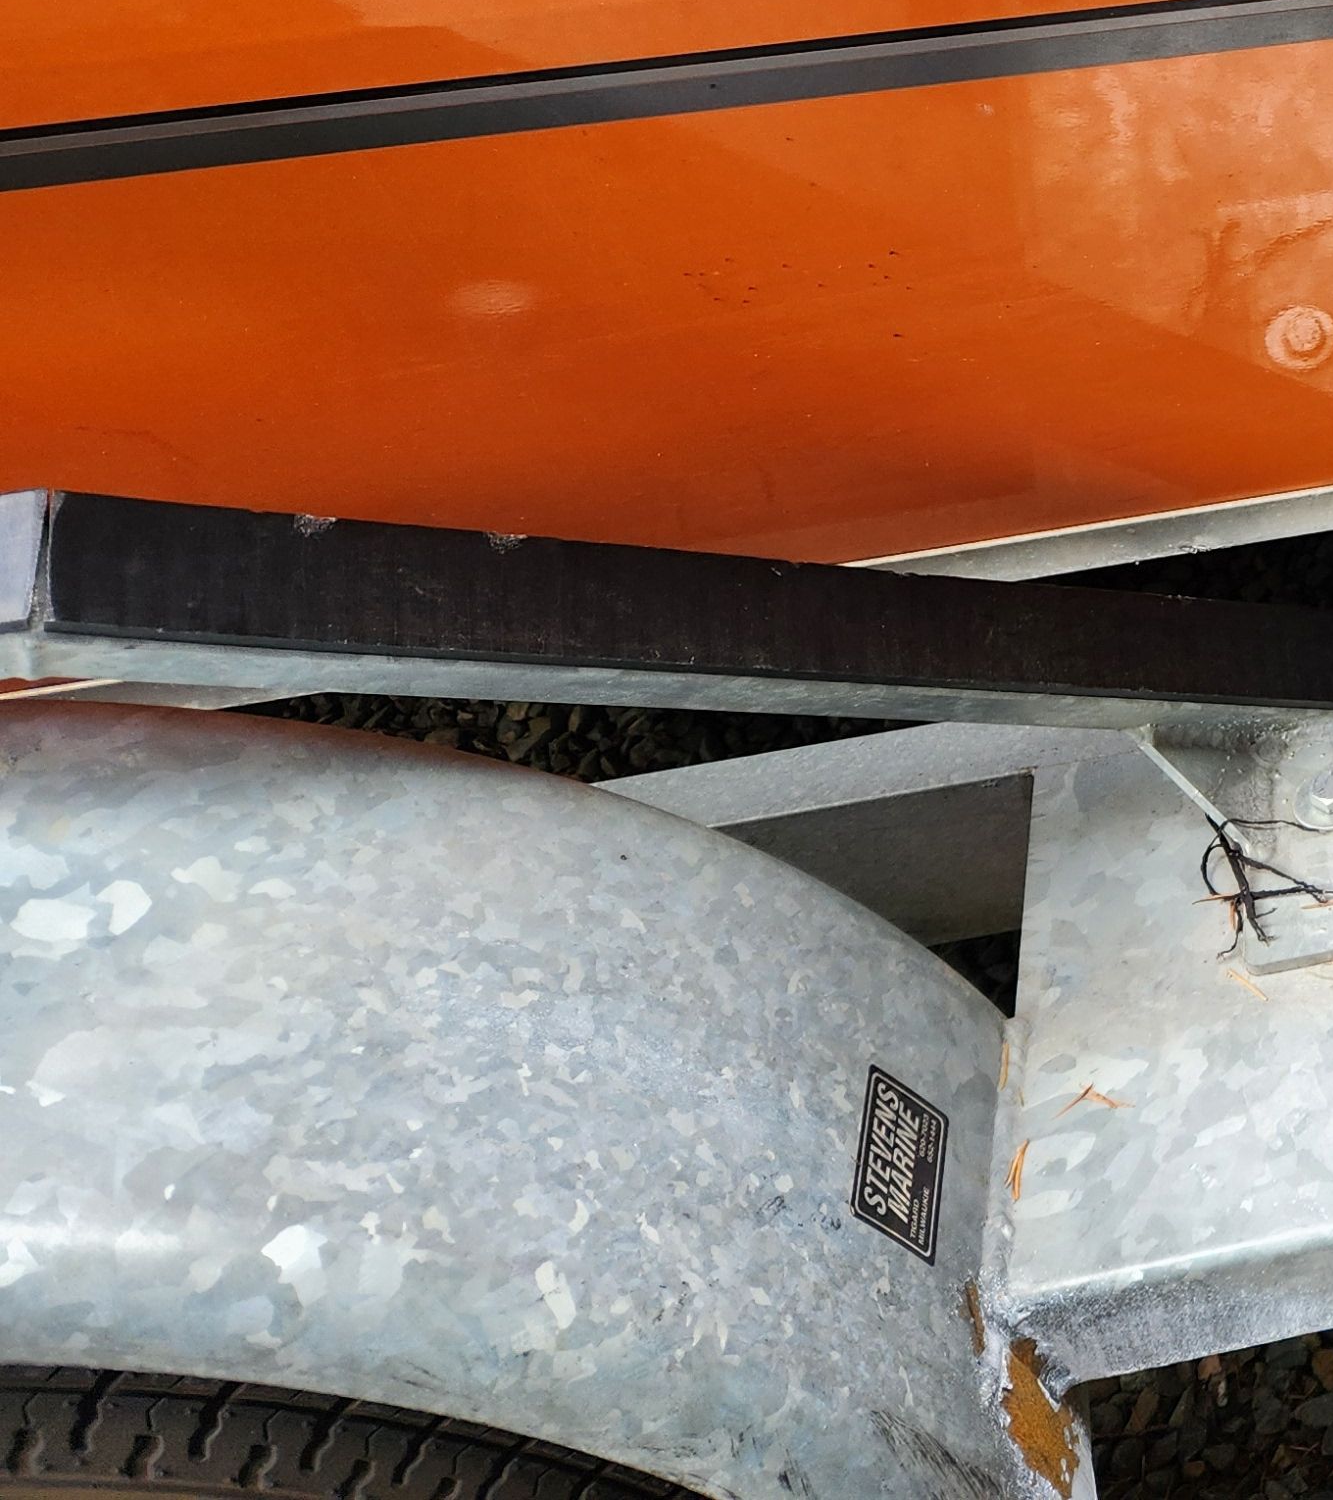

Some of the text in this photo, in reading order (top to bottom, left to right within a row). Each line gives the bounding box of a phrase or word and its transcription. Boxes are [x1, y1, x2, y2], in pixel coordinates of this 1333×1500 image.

[864, 1082, 899, 1215] STEVENS
[888, 1100, 920, 1223] MARINE
[910, 1199, 920, 1238] TIGARD
[918, 1186, 930, 1245] MILWAUKIE
